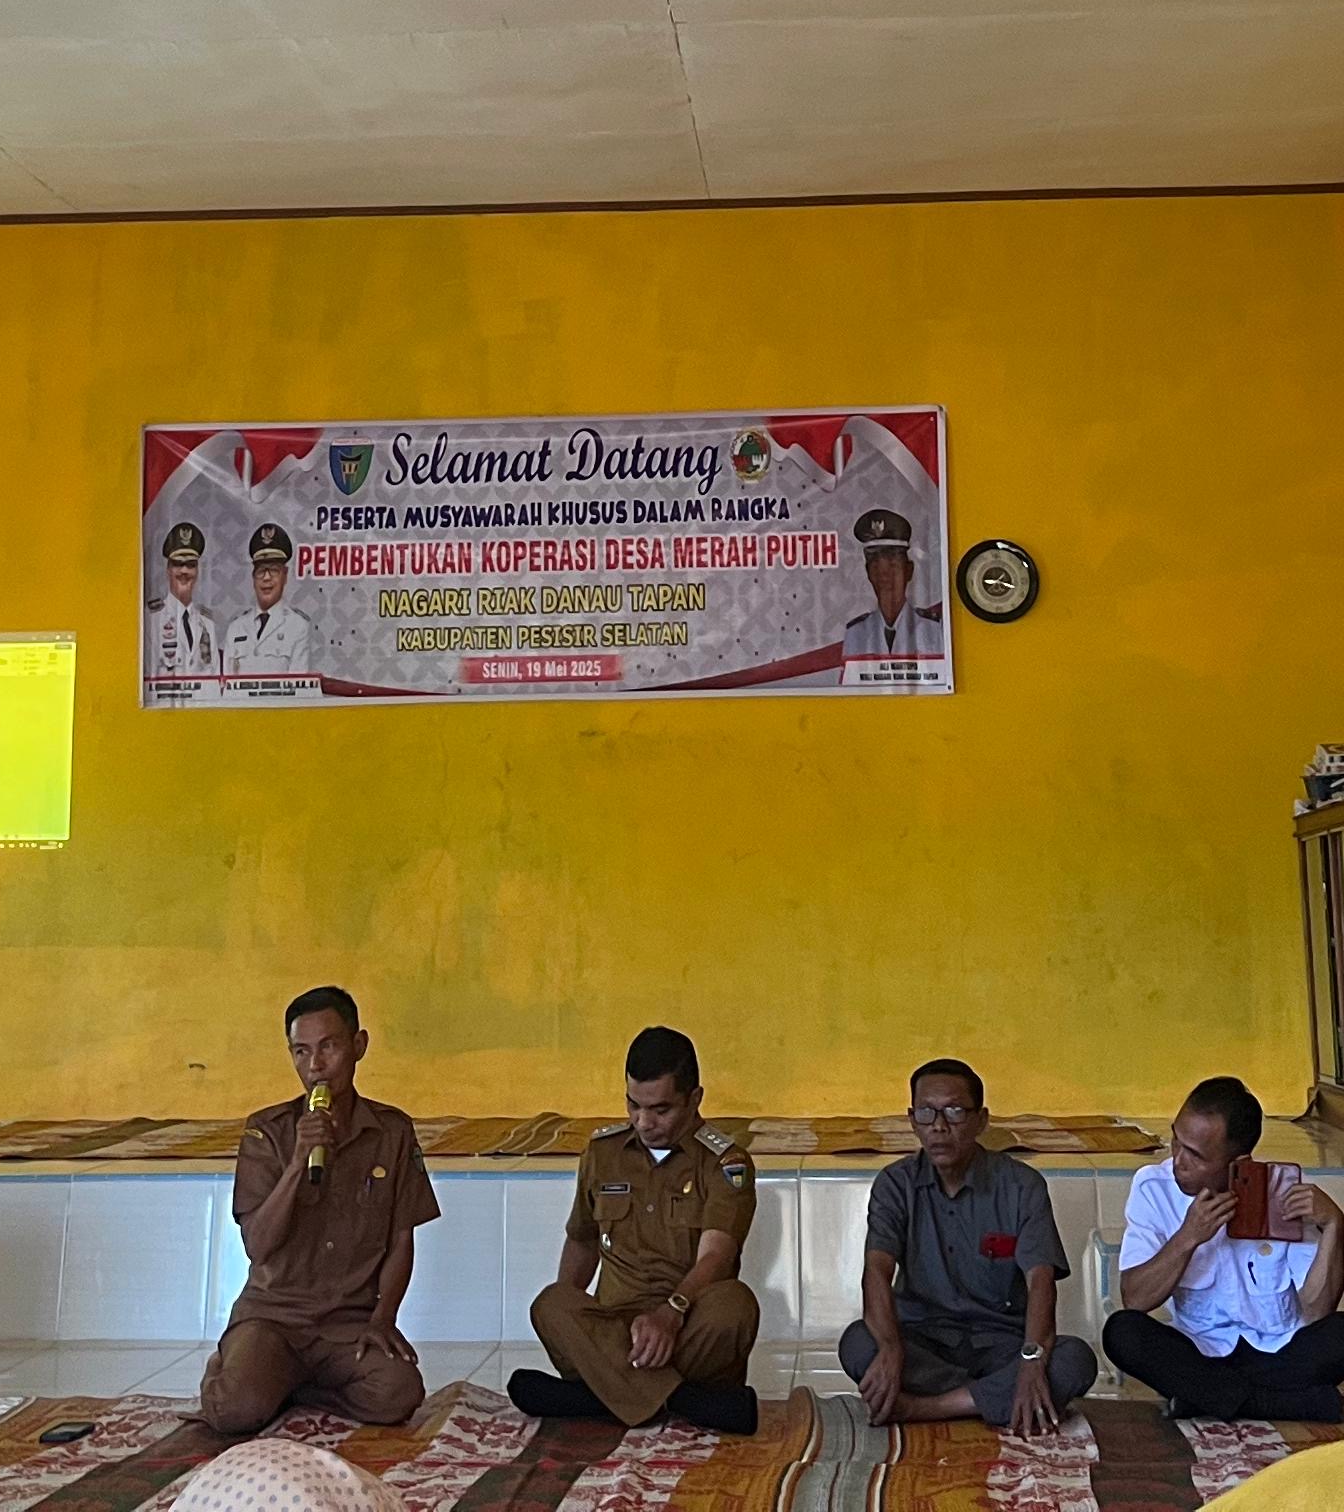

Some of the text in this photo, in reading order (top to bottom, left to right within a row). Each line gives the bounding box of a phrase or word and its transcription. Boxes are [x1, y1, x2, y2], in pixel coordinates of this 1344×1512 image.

[385, 427, 722, 496] Selamat Datang
[317, 497, 790, 531] PESERTA MUSYAWARAH KHUSUS DALAM RANGKA
[297, 533, 837, 578] PEMBENTUKAN KOPERASI DESA MERAH PUTIH
[379, 583, 706, 617] NAGARI RIAK DANAU TAPAN
[397, 622, 688, 651] KABUPATEN PESISIR SELATAN
[482, 660, 601, 678] SENIN, 19 Mei 2025
